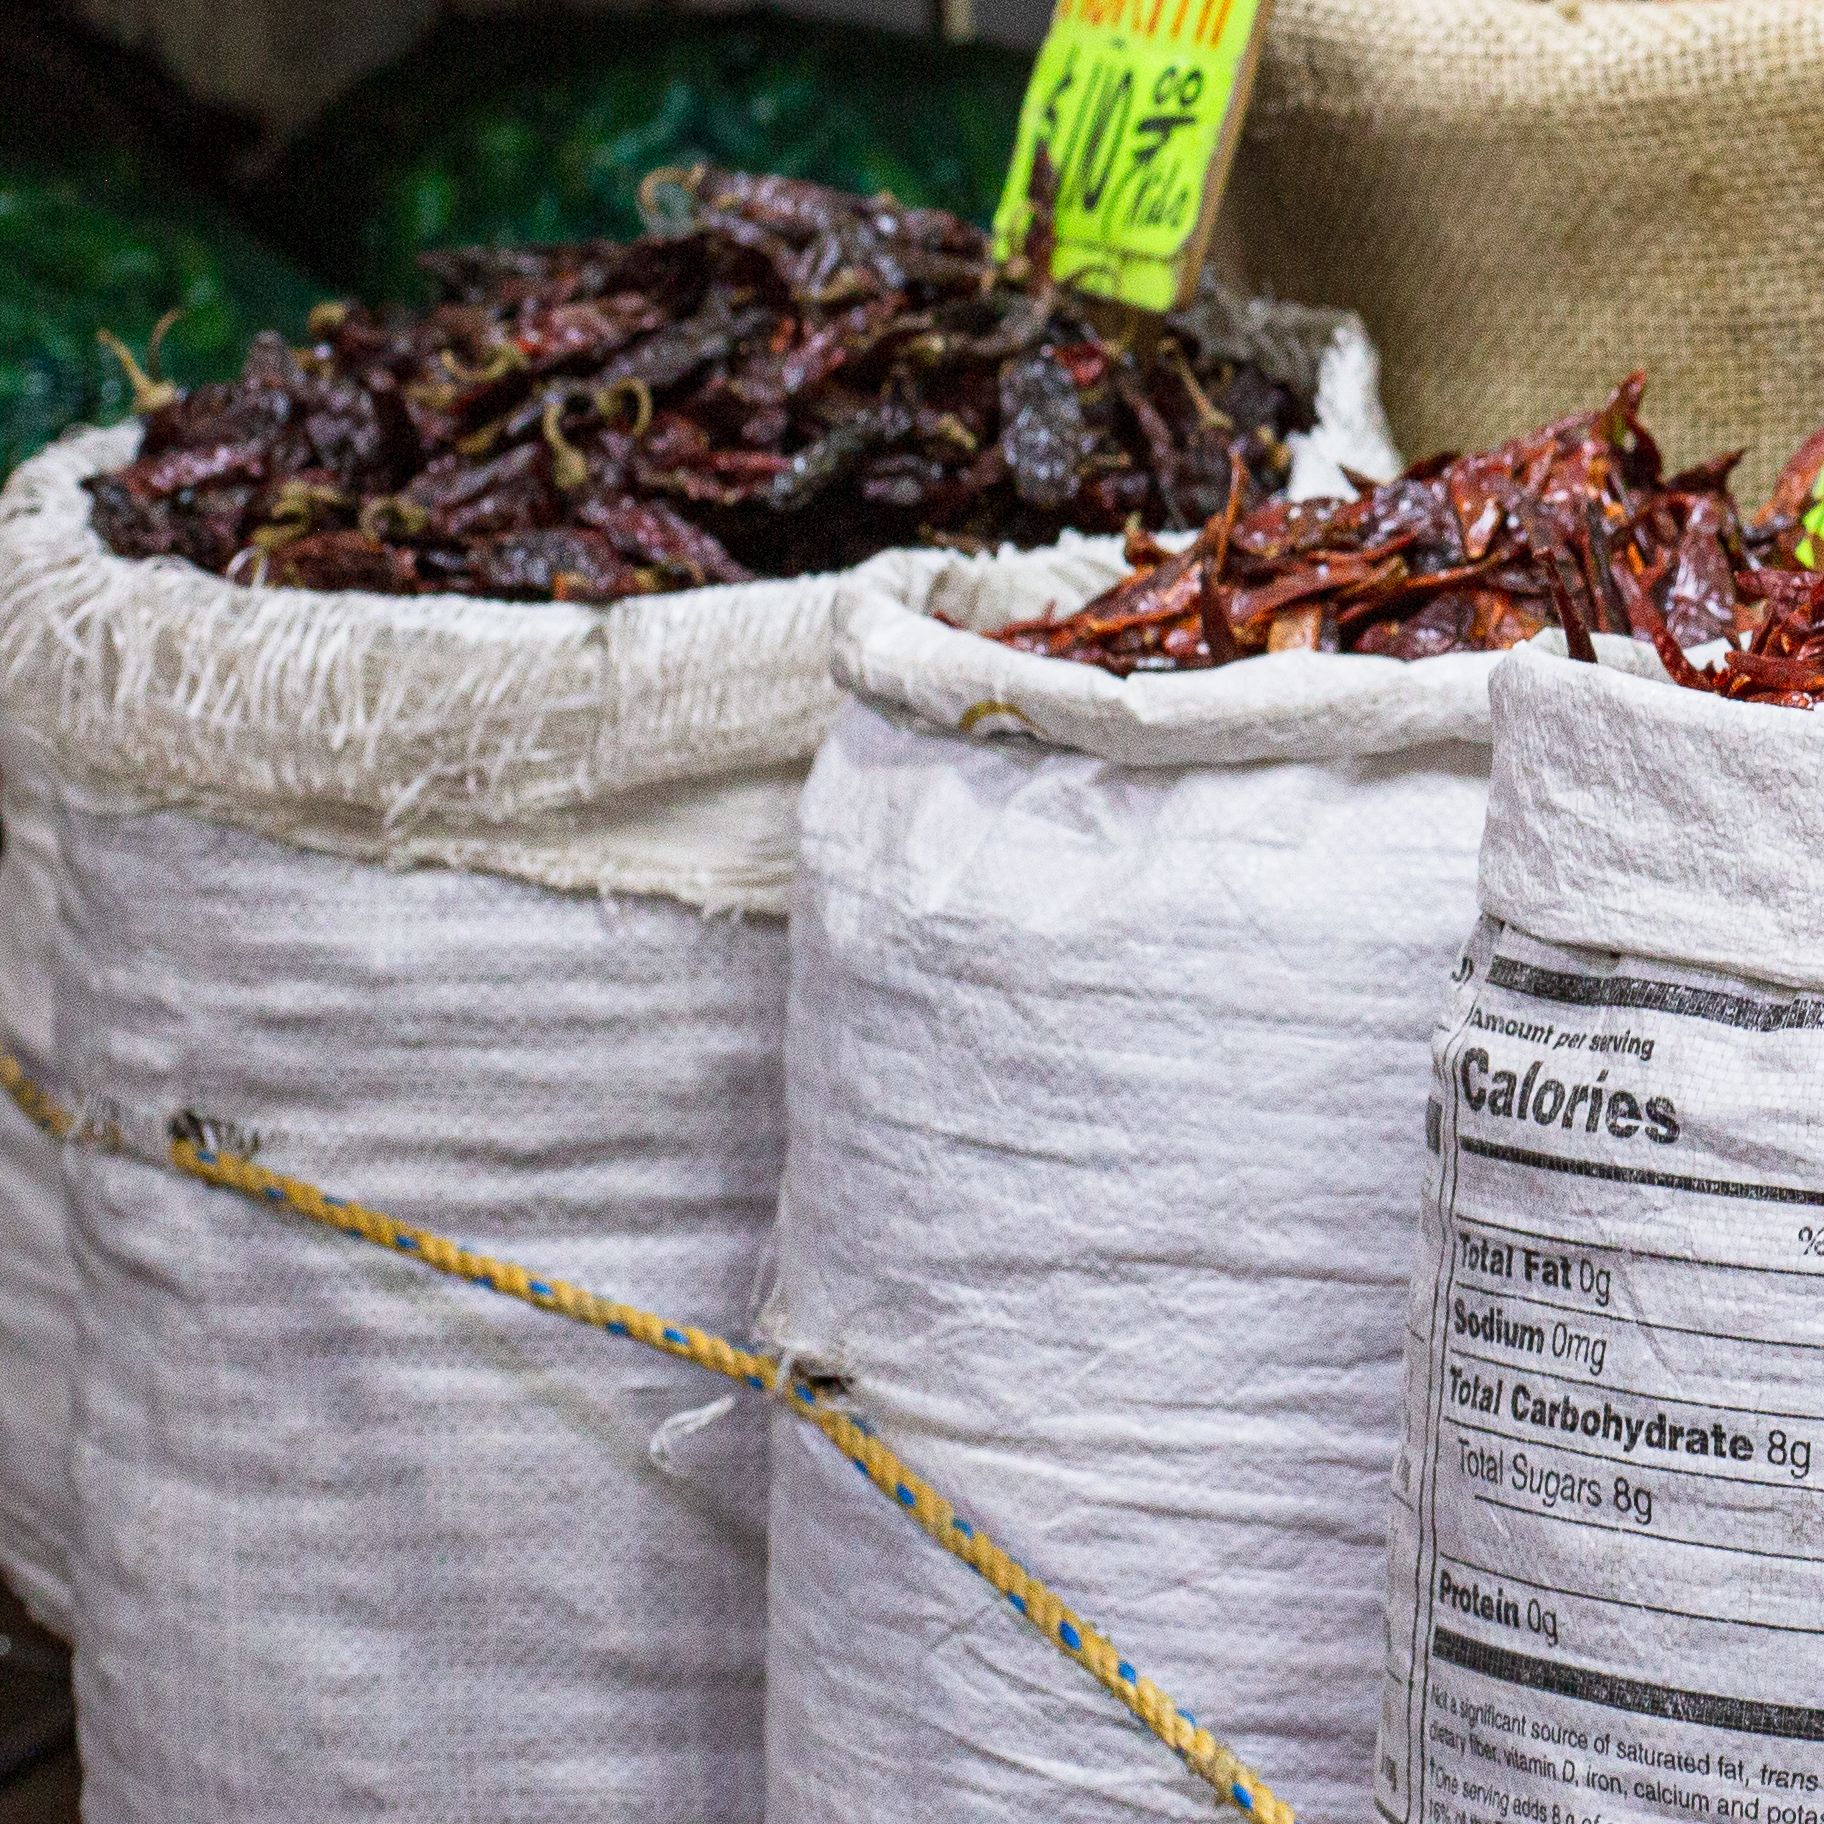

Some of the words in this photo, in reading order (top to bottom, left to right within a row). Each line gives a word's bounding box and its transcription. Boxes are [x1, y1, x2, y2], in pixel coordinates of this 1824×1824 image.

[1470, 1007, 1553, 1044] Amount
[1588, 1029, 1655, 1062] serving
[1460, 1046, 1681, 1145] Calories
[1458, 1231, 1513, 1277] Total
[1523, 1247, 1573, 1290] Fat
[1579, 1259, 1612, 1306] 0g
[1453, 1297, 1545, 1354] Sodium
[1551, 1322, 1608, 1375] 0mg
[1449, 1363, 1502, 1416] Total
[1510, 1383, 1755, 1462] Carbohydrate
[1767, 1429, 1812, 1479] 8g
[1457, 1437, 1503, 1486] Total
[1511, 1452, 1602, 1508] Sugars
[1612, 1476, 1653, 1525] 8g
[1439, 1571, 1521, 1629] Protein
[1526, 1599, 1559, 1647] 0g
[1460, 1697, 1527, 1737] significant
[1530, 1721, 1588, 1749] source
[1593, 1734, 1612, 1755] of
[1616, 1739, 1710, 1775] saturated
[1718, 1755, 1750, 1787] fat,
[1760, 1764, 1819, 1792] trans
[1462, 1778, 1509, 1816] serving
[1513, 1798, 1547, 1824] adds
[1503, 1748, 1556, 1780] vitamin
[1562, 1759, 1579, 1787] D,
[1586, 1764, 1628, 1799] iron,
[1634, 1780, 1709, 1813] calcium
[1717, 1798, 1759, 1821] and
